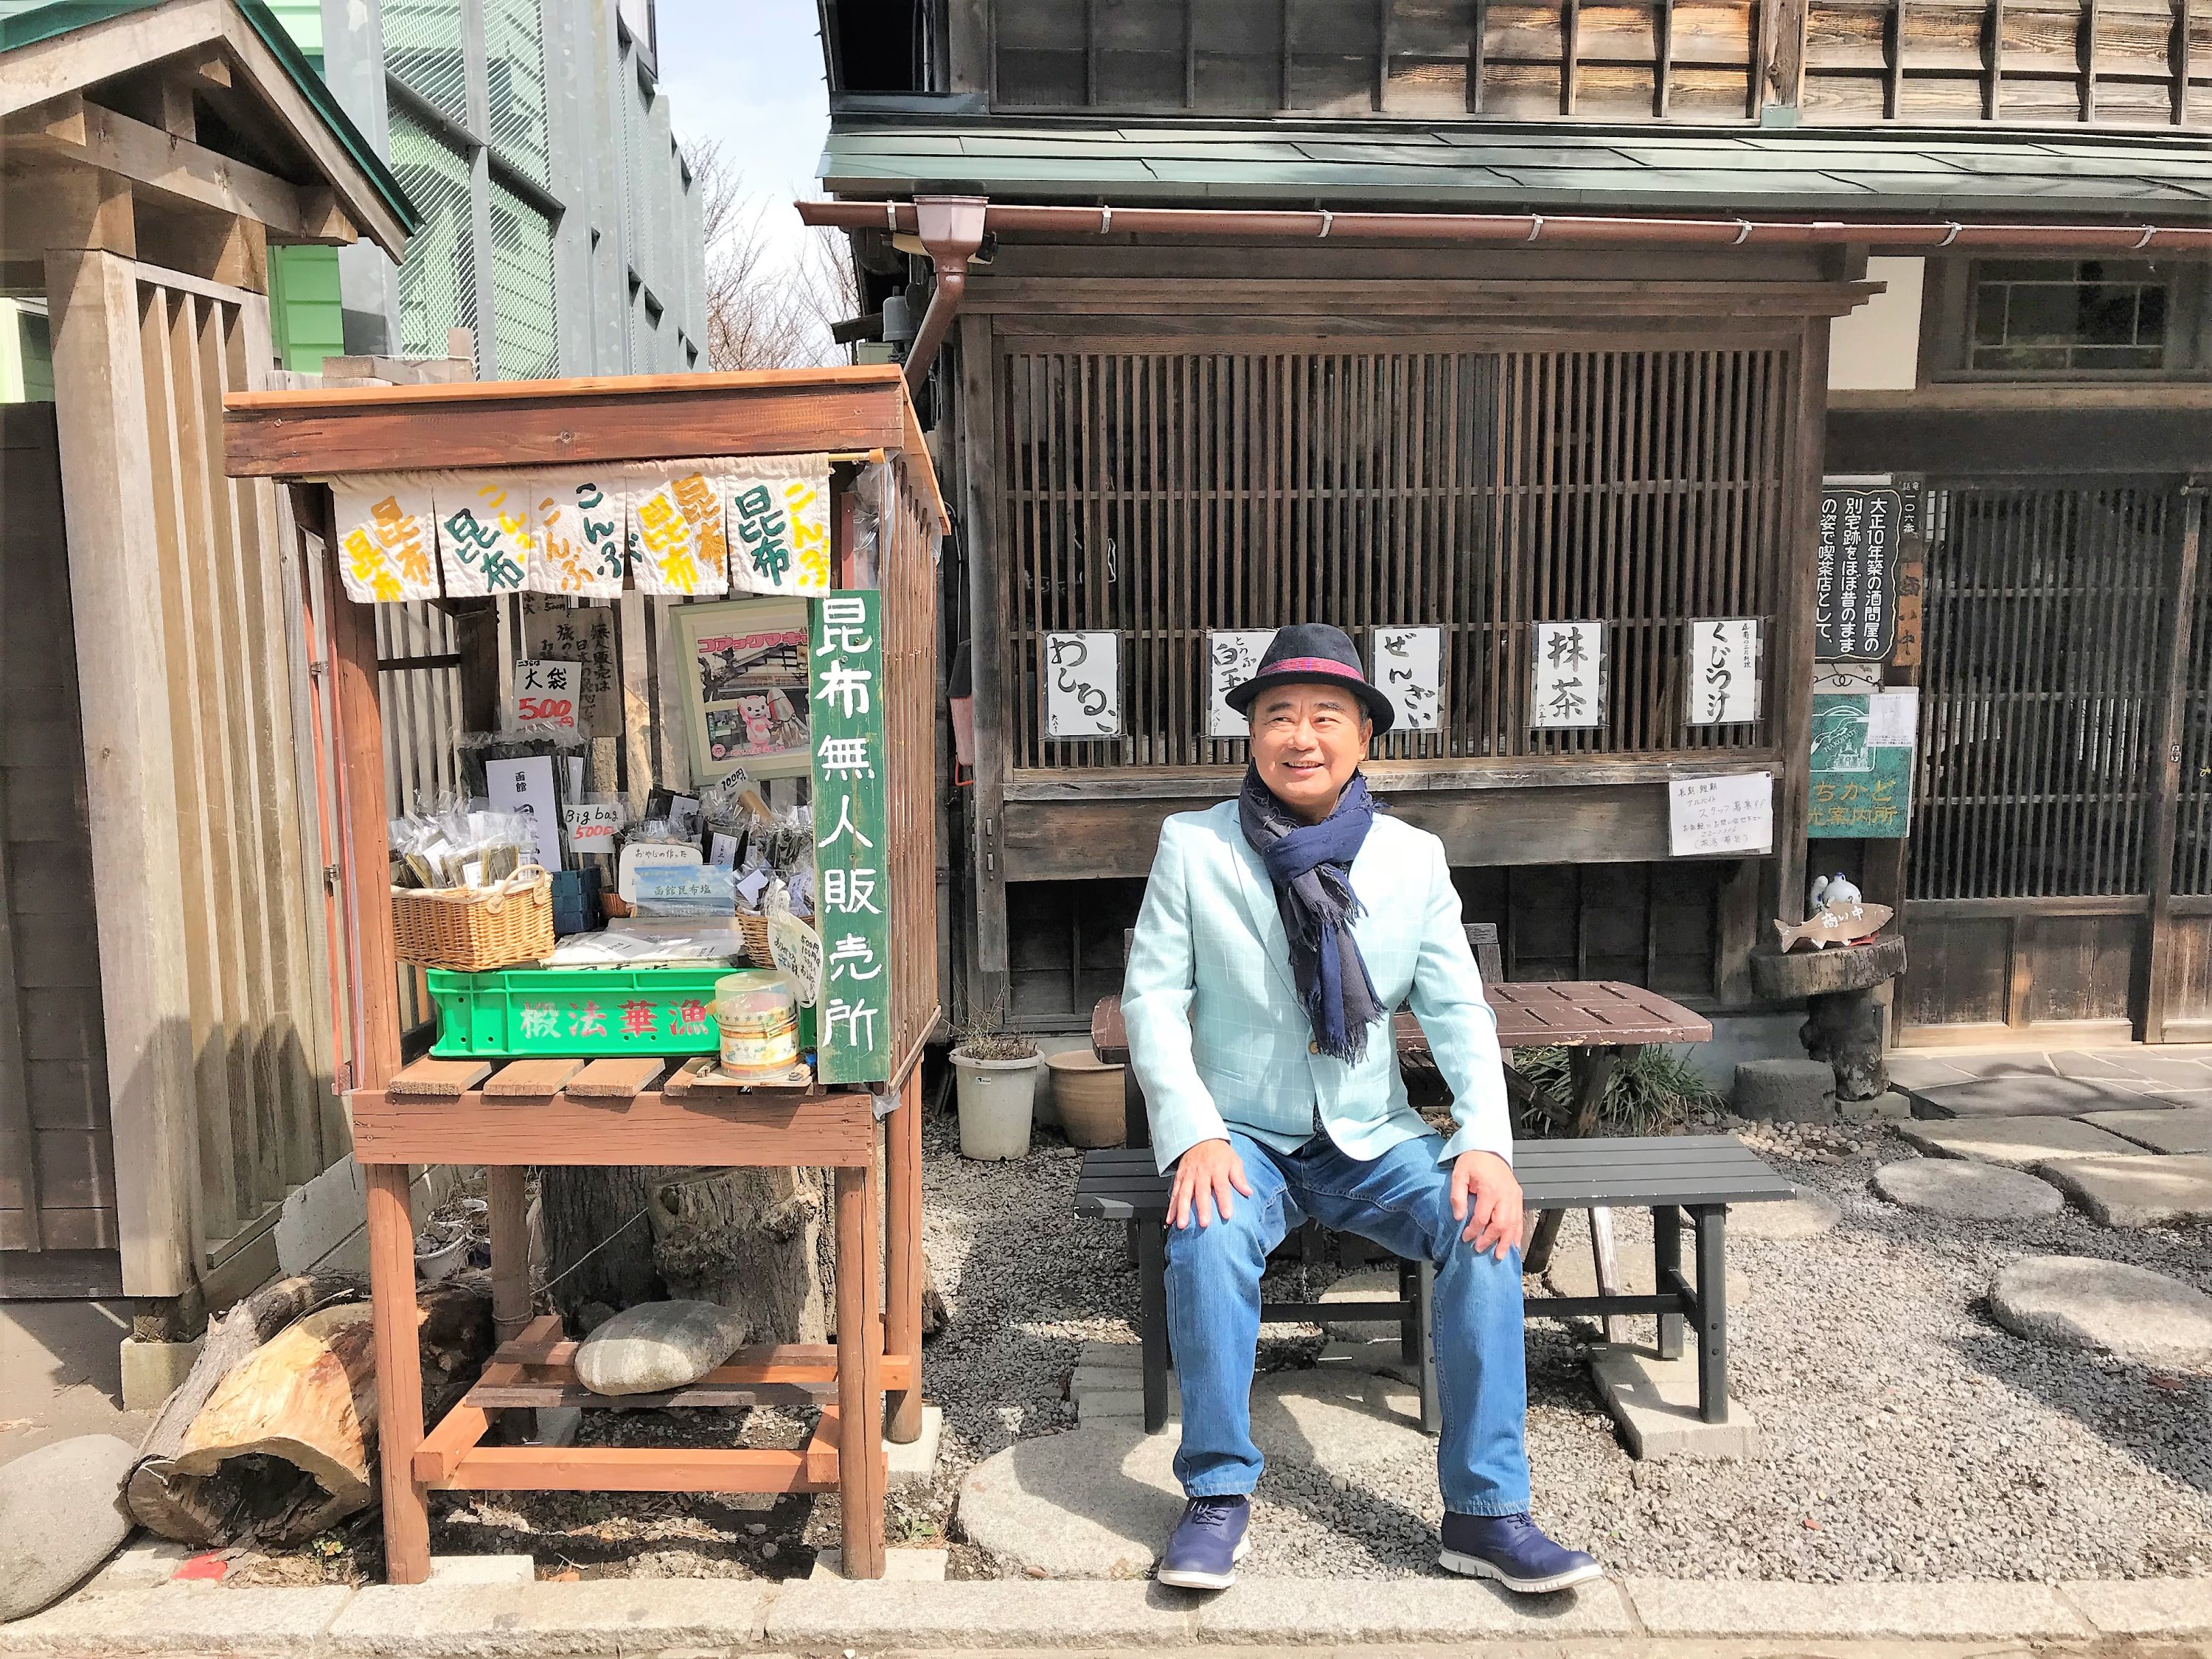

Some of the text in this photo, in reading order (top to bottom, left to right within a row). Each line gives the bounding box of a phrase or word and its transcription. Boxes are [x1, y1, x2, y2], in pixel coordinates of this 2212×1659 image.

[344, 529, 403, 602] 昆布
[371, 495, 431, 587] 昆布
[444, 508, 526, 592] 昆布
[637, 493, 698, 594] 昆布
[734, 484, 790, 587] 昆布
[1839, 497, 1863, 653] 別宅跡をほぼ昔のまま
[1863, 497, 1888, 653] 大正10年築の酒問屋の
[525, 667, 567, 690] 大袋
[1384, 633, 1436, 728] ぜんざい
[1547, 626, 1589, 720] 抹茶
[1705, 622, 1731, 723] くじら汁
[1823, 728, 1858, 753] HAKODATE
[565, 807, 619, 825] Big bag
[636, 849, 687, 859] おやじの作った
[814, 597, 885, 1053] 昆布無人販売所
[1699, 805, 1730, 818] スタッフ
[654, 884, 712, 897] 函館昆布塩
[1821, 905, 1864, 929] 商い中
